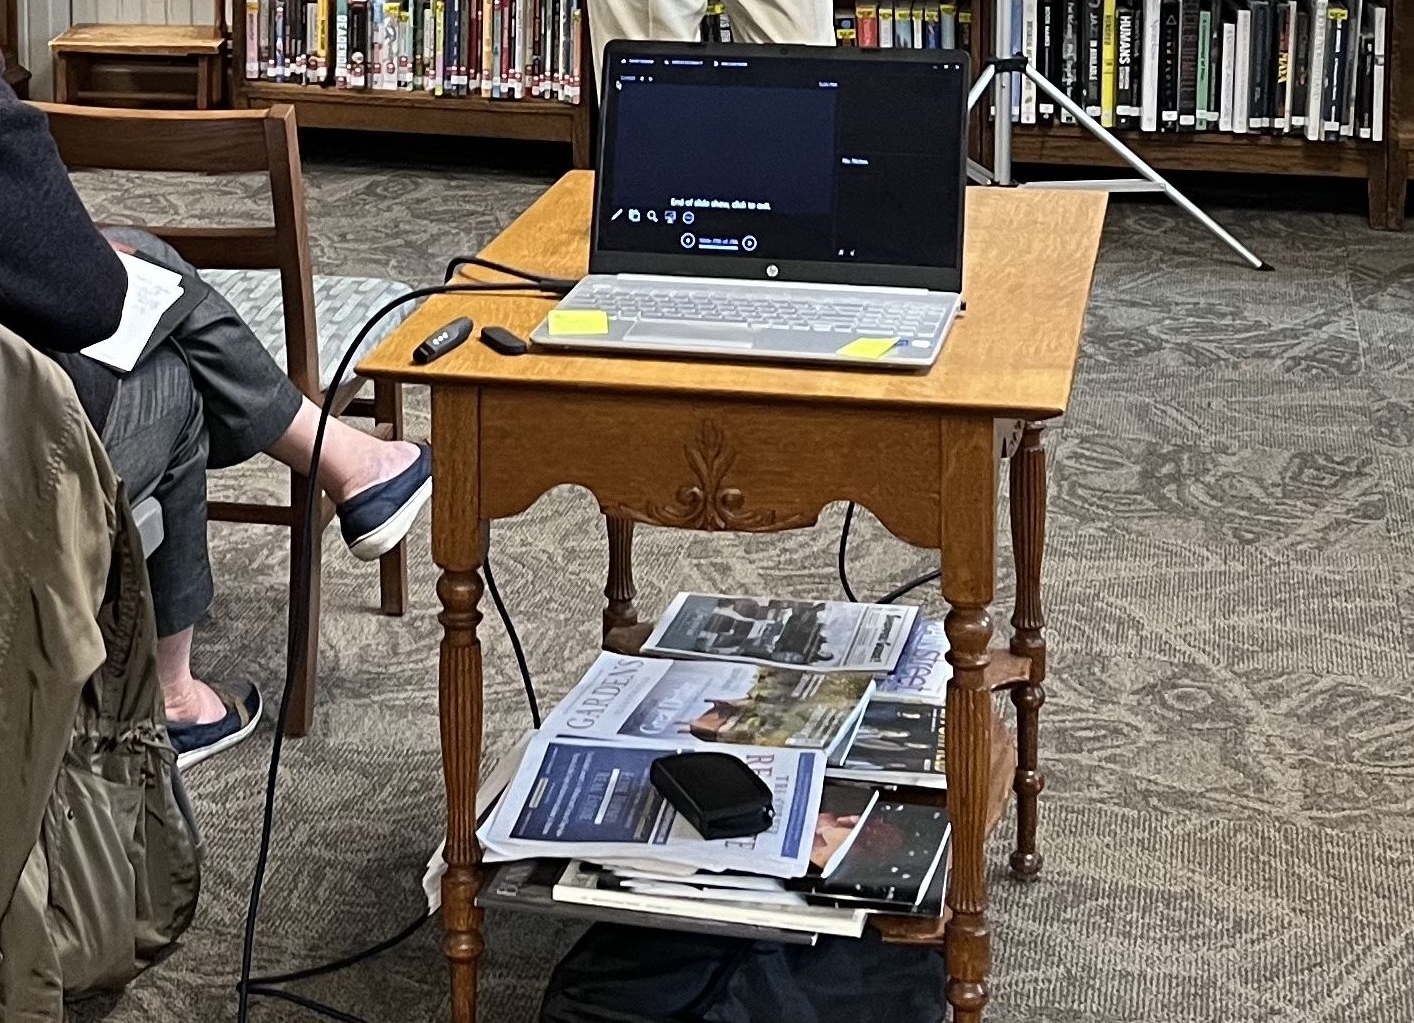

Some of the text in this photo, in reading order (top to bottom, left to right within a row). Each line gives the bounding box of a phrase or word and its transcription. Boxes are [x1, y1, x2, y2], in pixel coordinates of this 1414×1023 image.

[1119, 16, 1131, 64] HUMANS
[670, 197, 684, 207] End
[685, 198, 694, 207] of
[694, 199, 710, 208] slide
[731, 200, 747, 209] click
[747, 201, 756, 210] to
[566, 658, 644, 728] GARDENS
